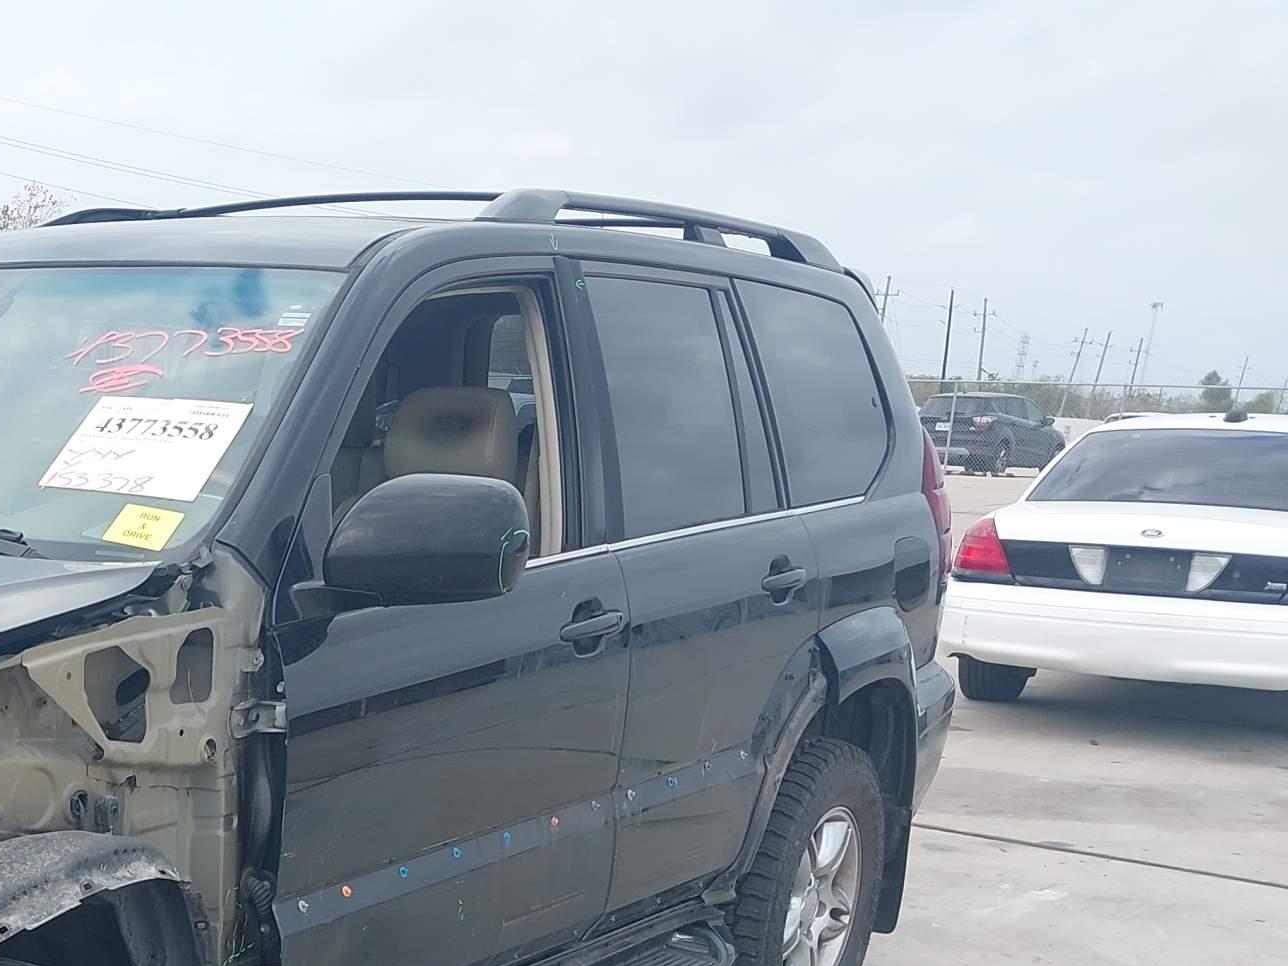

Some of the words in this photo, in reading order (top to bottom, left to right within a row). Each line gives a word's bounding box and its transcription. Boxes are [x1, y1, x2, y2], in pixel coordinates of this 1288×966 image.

[96, 416, 219, 441] 43773558
[139, 512, 161, 521] RUN
[139, 522, 147, 530] &
[122, 529, 153, 541] DRIVE
